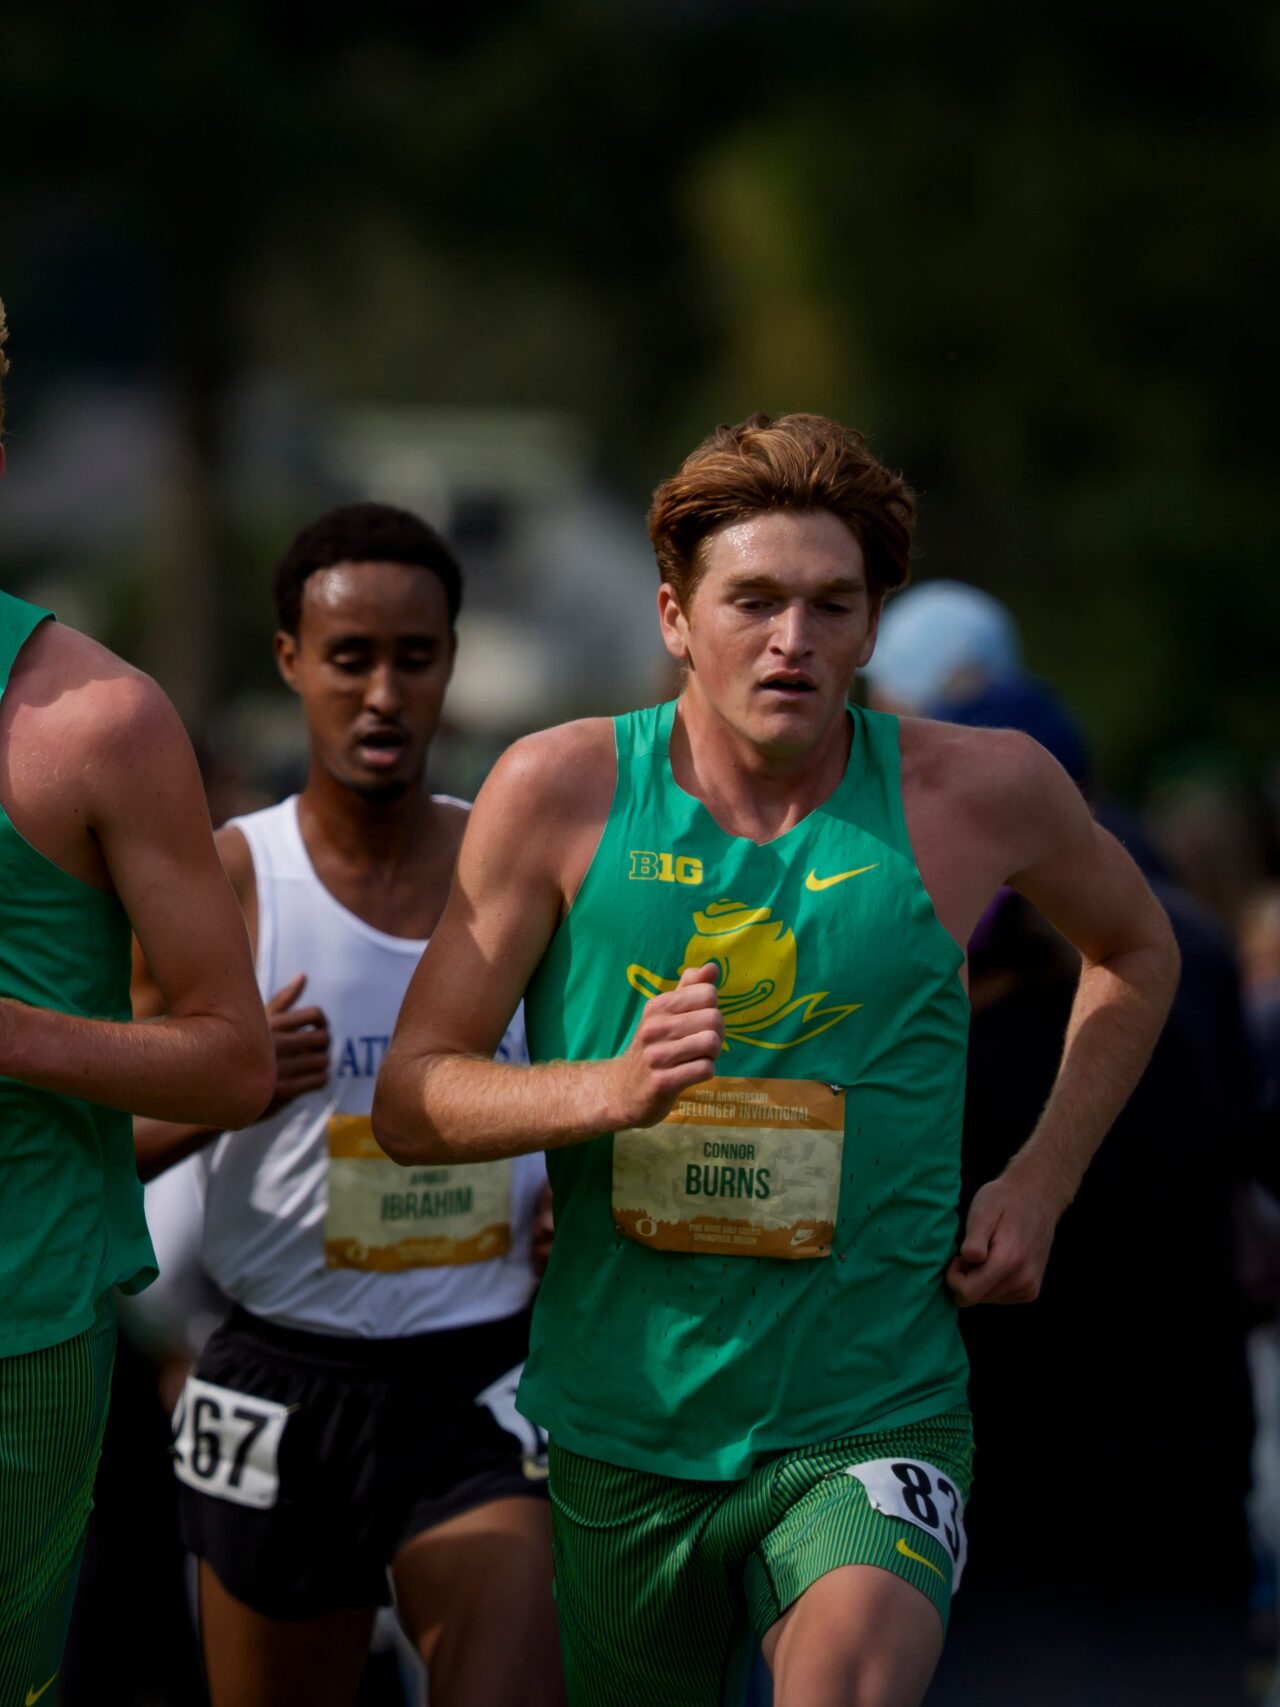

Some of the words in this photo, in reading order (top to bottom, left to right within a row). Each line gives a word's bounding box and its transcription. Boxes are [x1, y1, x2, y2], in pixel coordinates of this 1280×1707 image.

[717, 1091, 768, 1104] ANNIVERSARY
[679, 1101, 736, 1119] DELLINGER
[740, 1104, 810, 1121] INVITATIONAL
[703, 1142, 755, 1160] CONNOR
[685, 1164, 771, 1199] BURNS
[381, 1185, 472, 1221] IBRAHIM
